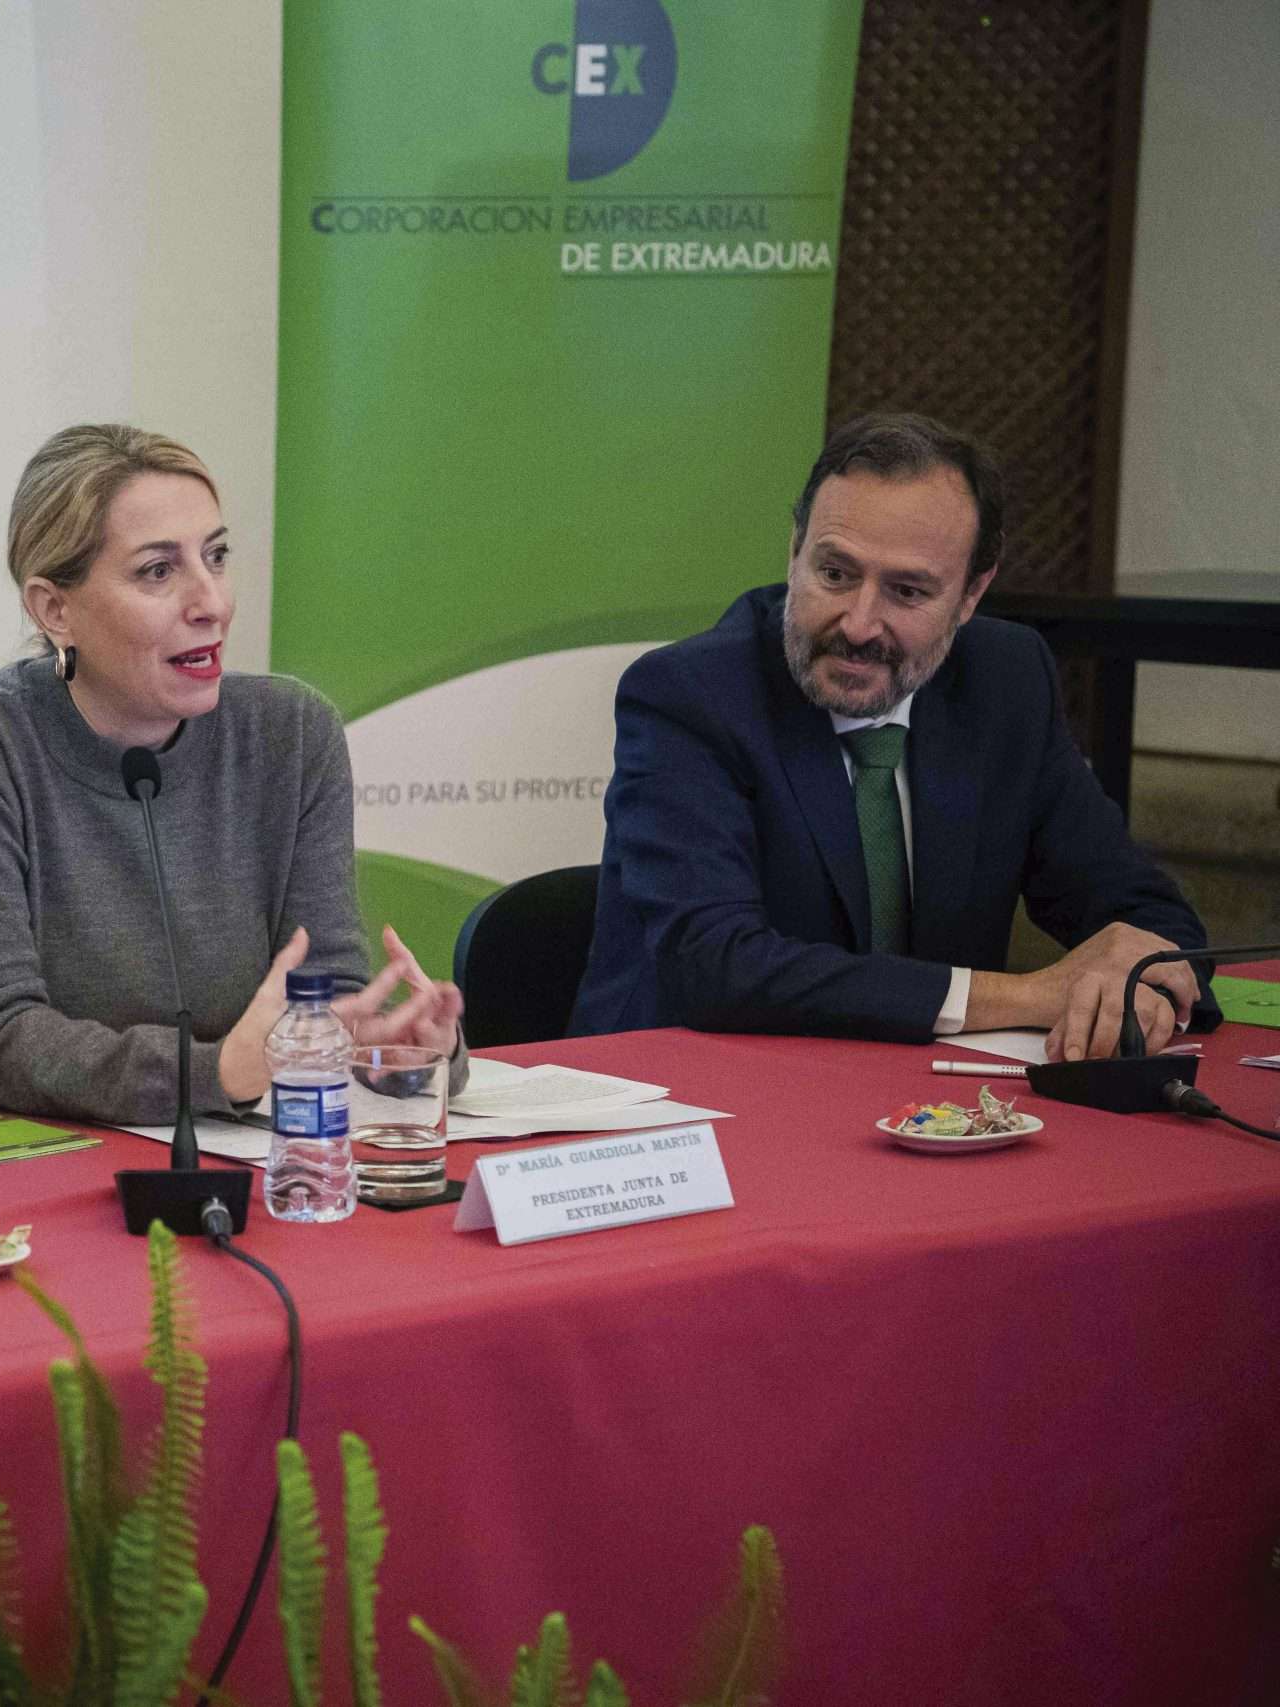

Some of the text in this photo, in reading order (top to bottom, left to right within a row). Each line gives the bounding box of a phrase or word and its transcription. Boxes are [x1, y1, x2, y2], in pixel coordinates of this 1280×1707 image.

[531, 43, 646, 95] CEX
[563, 204, 770, 233] EMPRESARIAL
[560, 240, 832, 272] DE EXTREMADURA
[408, 780, 469, 804] PARA
[476, 779, 506, 802] SU
[513, 776, 610, 801] PROYEC
[518, 1153, 563, 1173] MARÍA
[569, 1143, 646, 1164] GUARDIOLA
[652, 1132, 702, 1151] MARTÍN
[532, 1171, 689, 1207] PRESIDENTA JUNTA DE
[566, 1194, 665, 1221] EXTREMADURA
